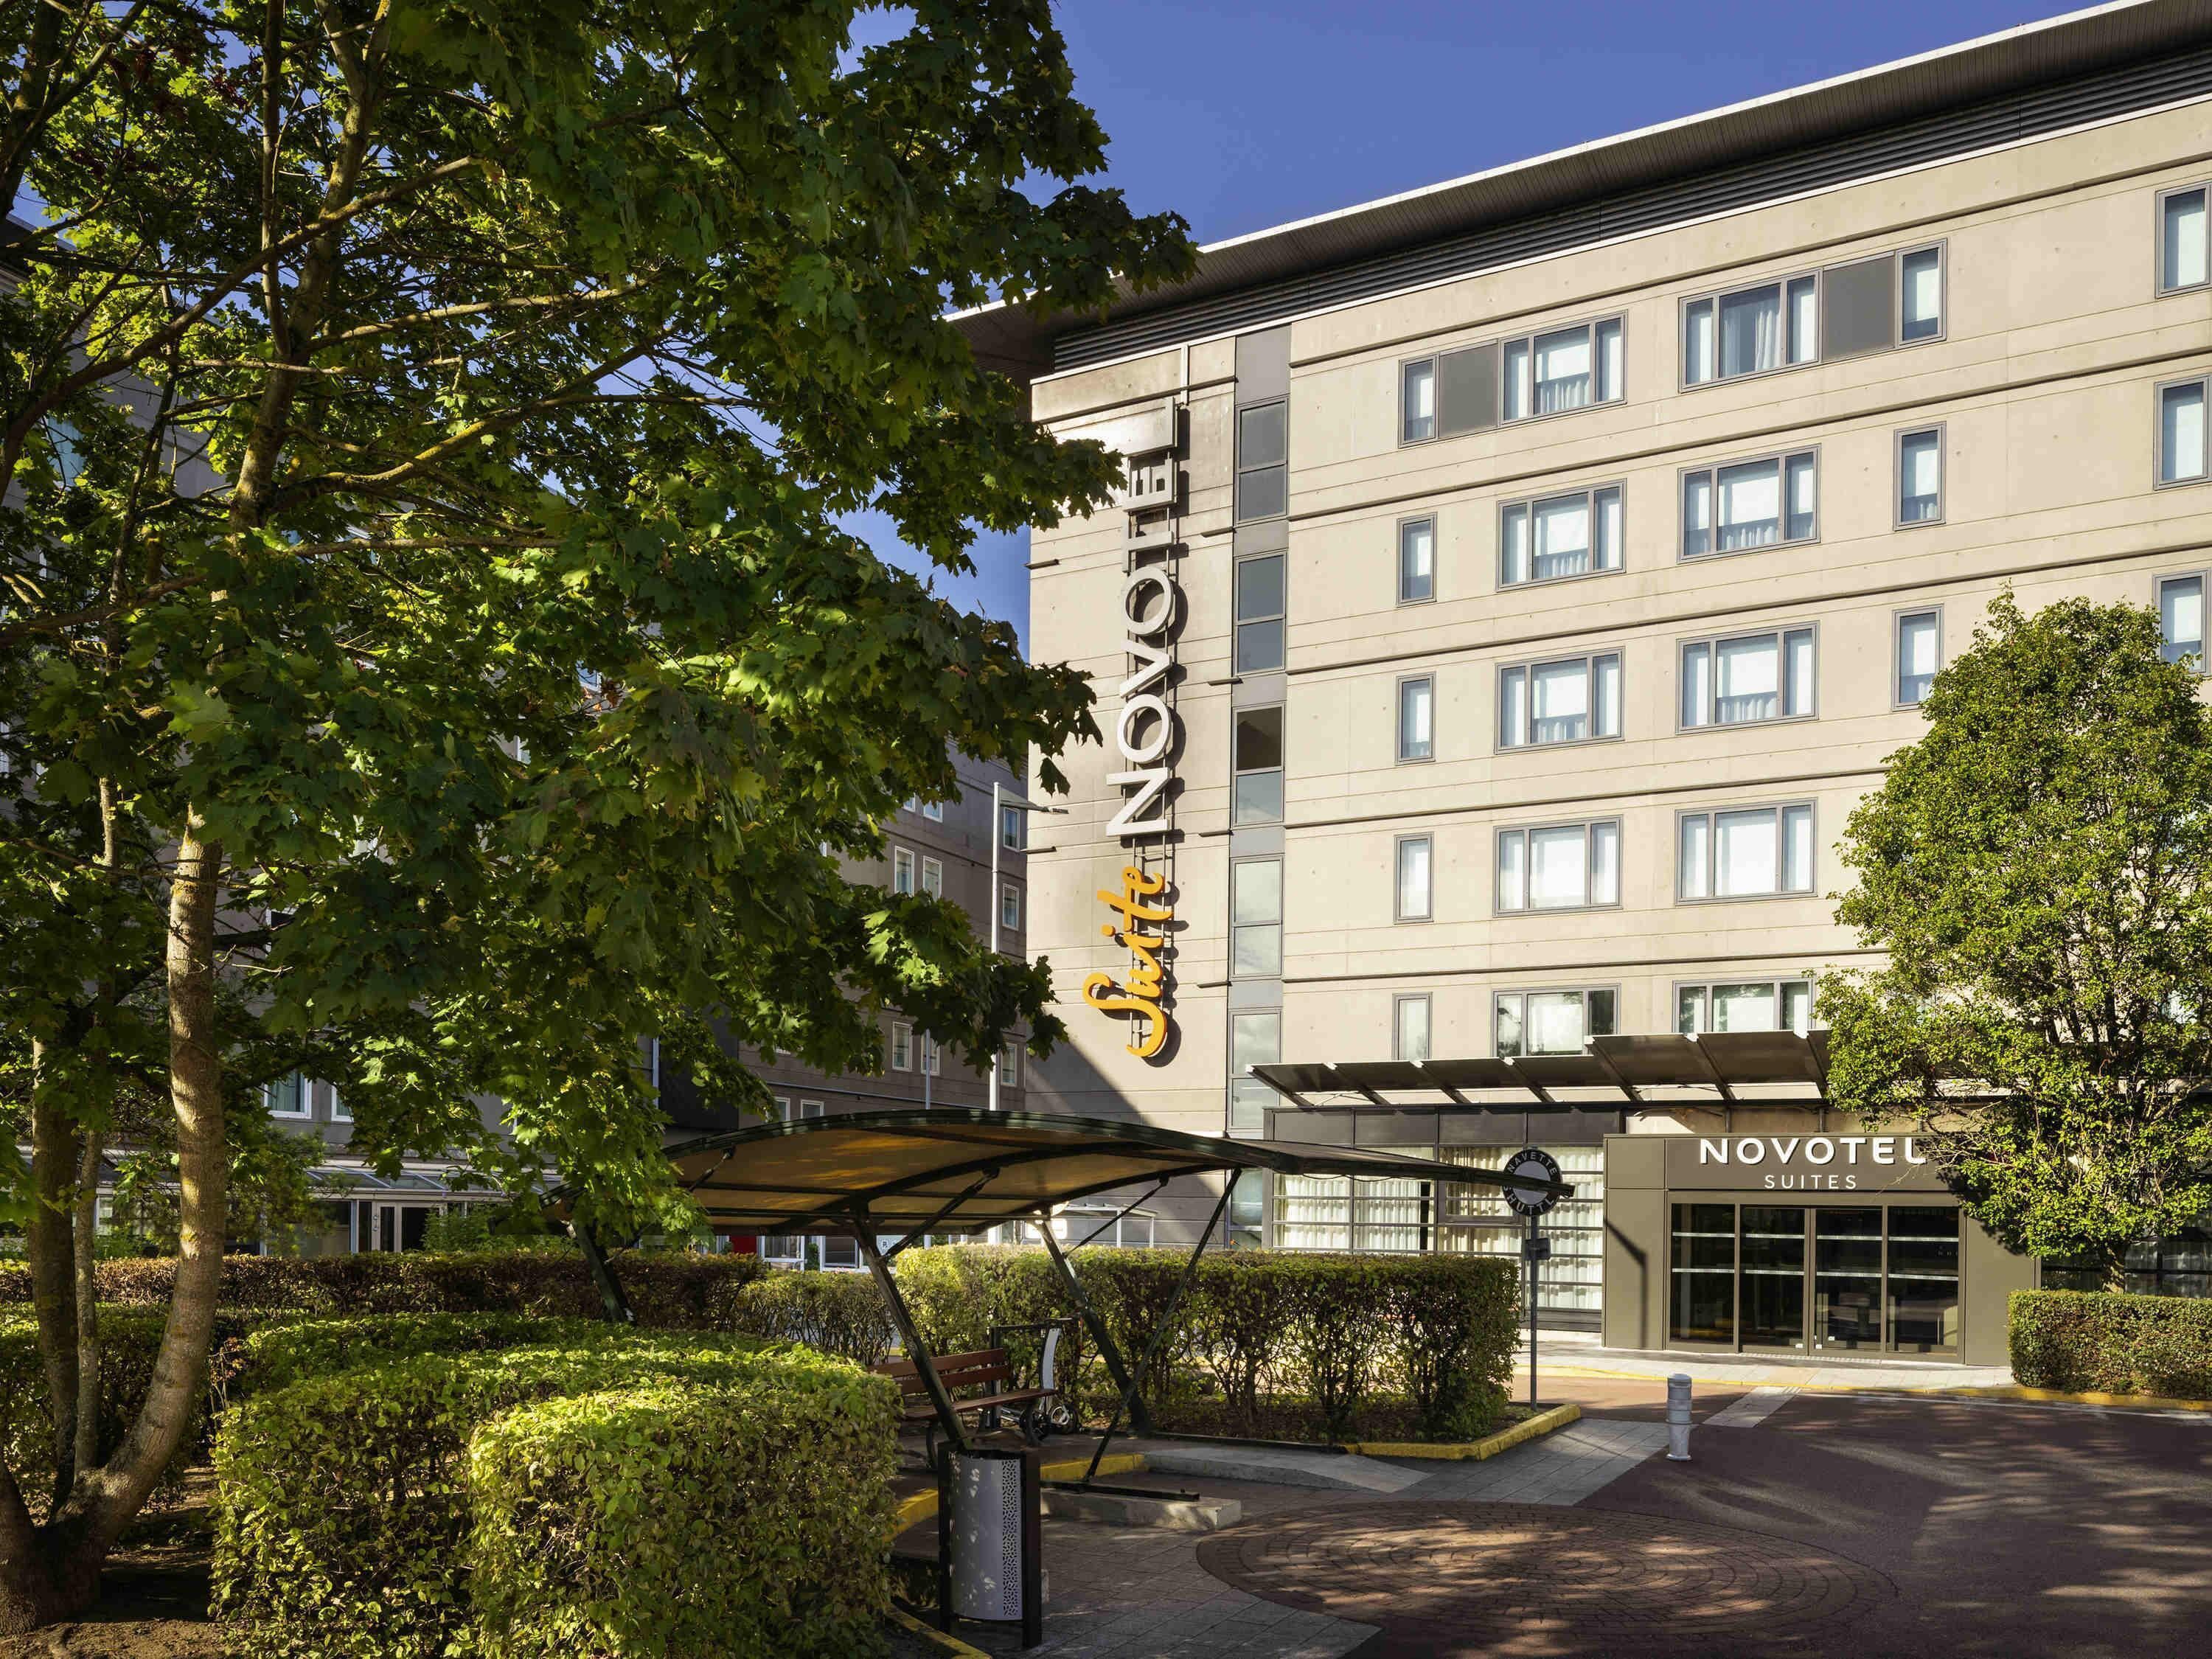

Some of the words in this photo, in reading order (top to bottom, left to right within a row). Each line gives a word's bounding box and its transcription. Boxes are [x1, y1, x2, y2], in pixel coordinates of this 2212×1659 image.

[1106, 396, 1175, 837] NOVOTEL
[1082, 866, 1173, 1057] Suite
[1508, 1152, 1557, 1175] NAVETTE
[1700, 1138, 1927, 1164] NOVOTEL
[1764, 1175, 1857, 1189] SUITES
[1503, 1186, 1554, 1215] SHUTTL
